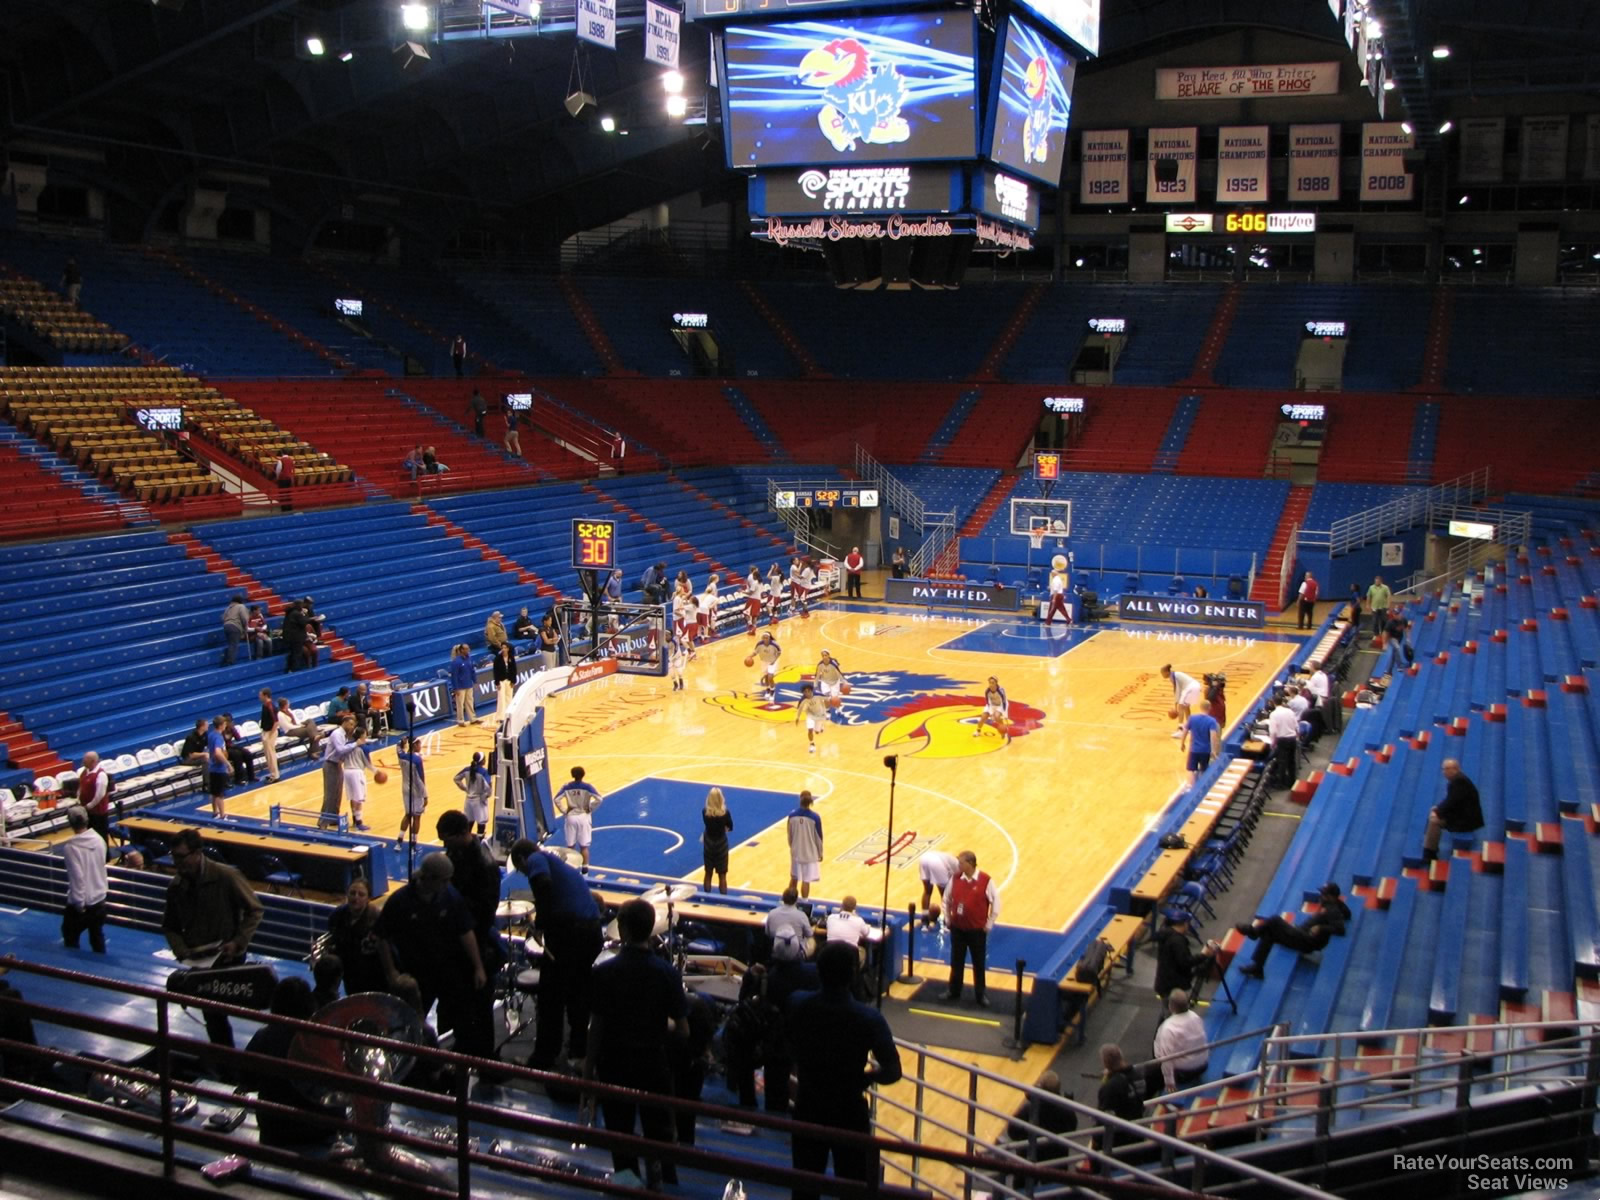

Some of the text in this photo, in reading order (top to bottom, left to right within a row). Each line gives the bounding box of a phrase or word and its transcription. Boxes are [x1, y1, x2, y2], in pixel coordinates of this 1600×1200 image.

[1177, 71, 1197, 84] Pay
[1177, 82, 1221, 98] BEWARE
[1229, 81, 1245, 94] OF
[847, 90, 877, 115] KU
[1087, 142, 1123, 150] NATIONAL
[1154, 140, 1191, 148] NATIONAL
[1224, 138, 1262, 147] NATIONAL
[1296, 136, 1334, 145] NATIONAL
[1368, 135, 1409, 145] NATIONAL
[1083, 153, 1126, 162] CHAMPIONS
[1150, 151, 1195, 161] CHAMPIONS
[1220, 150, 1265, 160] CHAMPIONS
[1290, 149, 1338, 158] CHAMPIONS
[1363, 149, 1406, 158] CHAMPIO
[825, 176, 911, 200] SPORTS
[1089, 180, 1120, 194] 1922
[1155, 178, 1186, 193] 1923
[1226, 178, 1258, 192] 1952
[1297, 177, 1330, 191] 1988
[1368, 176, 1406, 190] 2008
[1226, 213, 1266, 231] 6:06
[764, 214, 952, 246] Russell Stover Candies
[1039, 464, 1056, 477] 30
[578, 523, 612, 538] 52:02
[582, 539, 607, 563] 30
[912, 586, 939, 598] PAY
[1126, 600, 1257, 620] ALL WHO ENTER
[412, 686, 441, 718] KU
